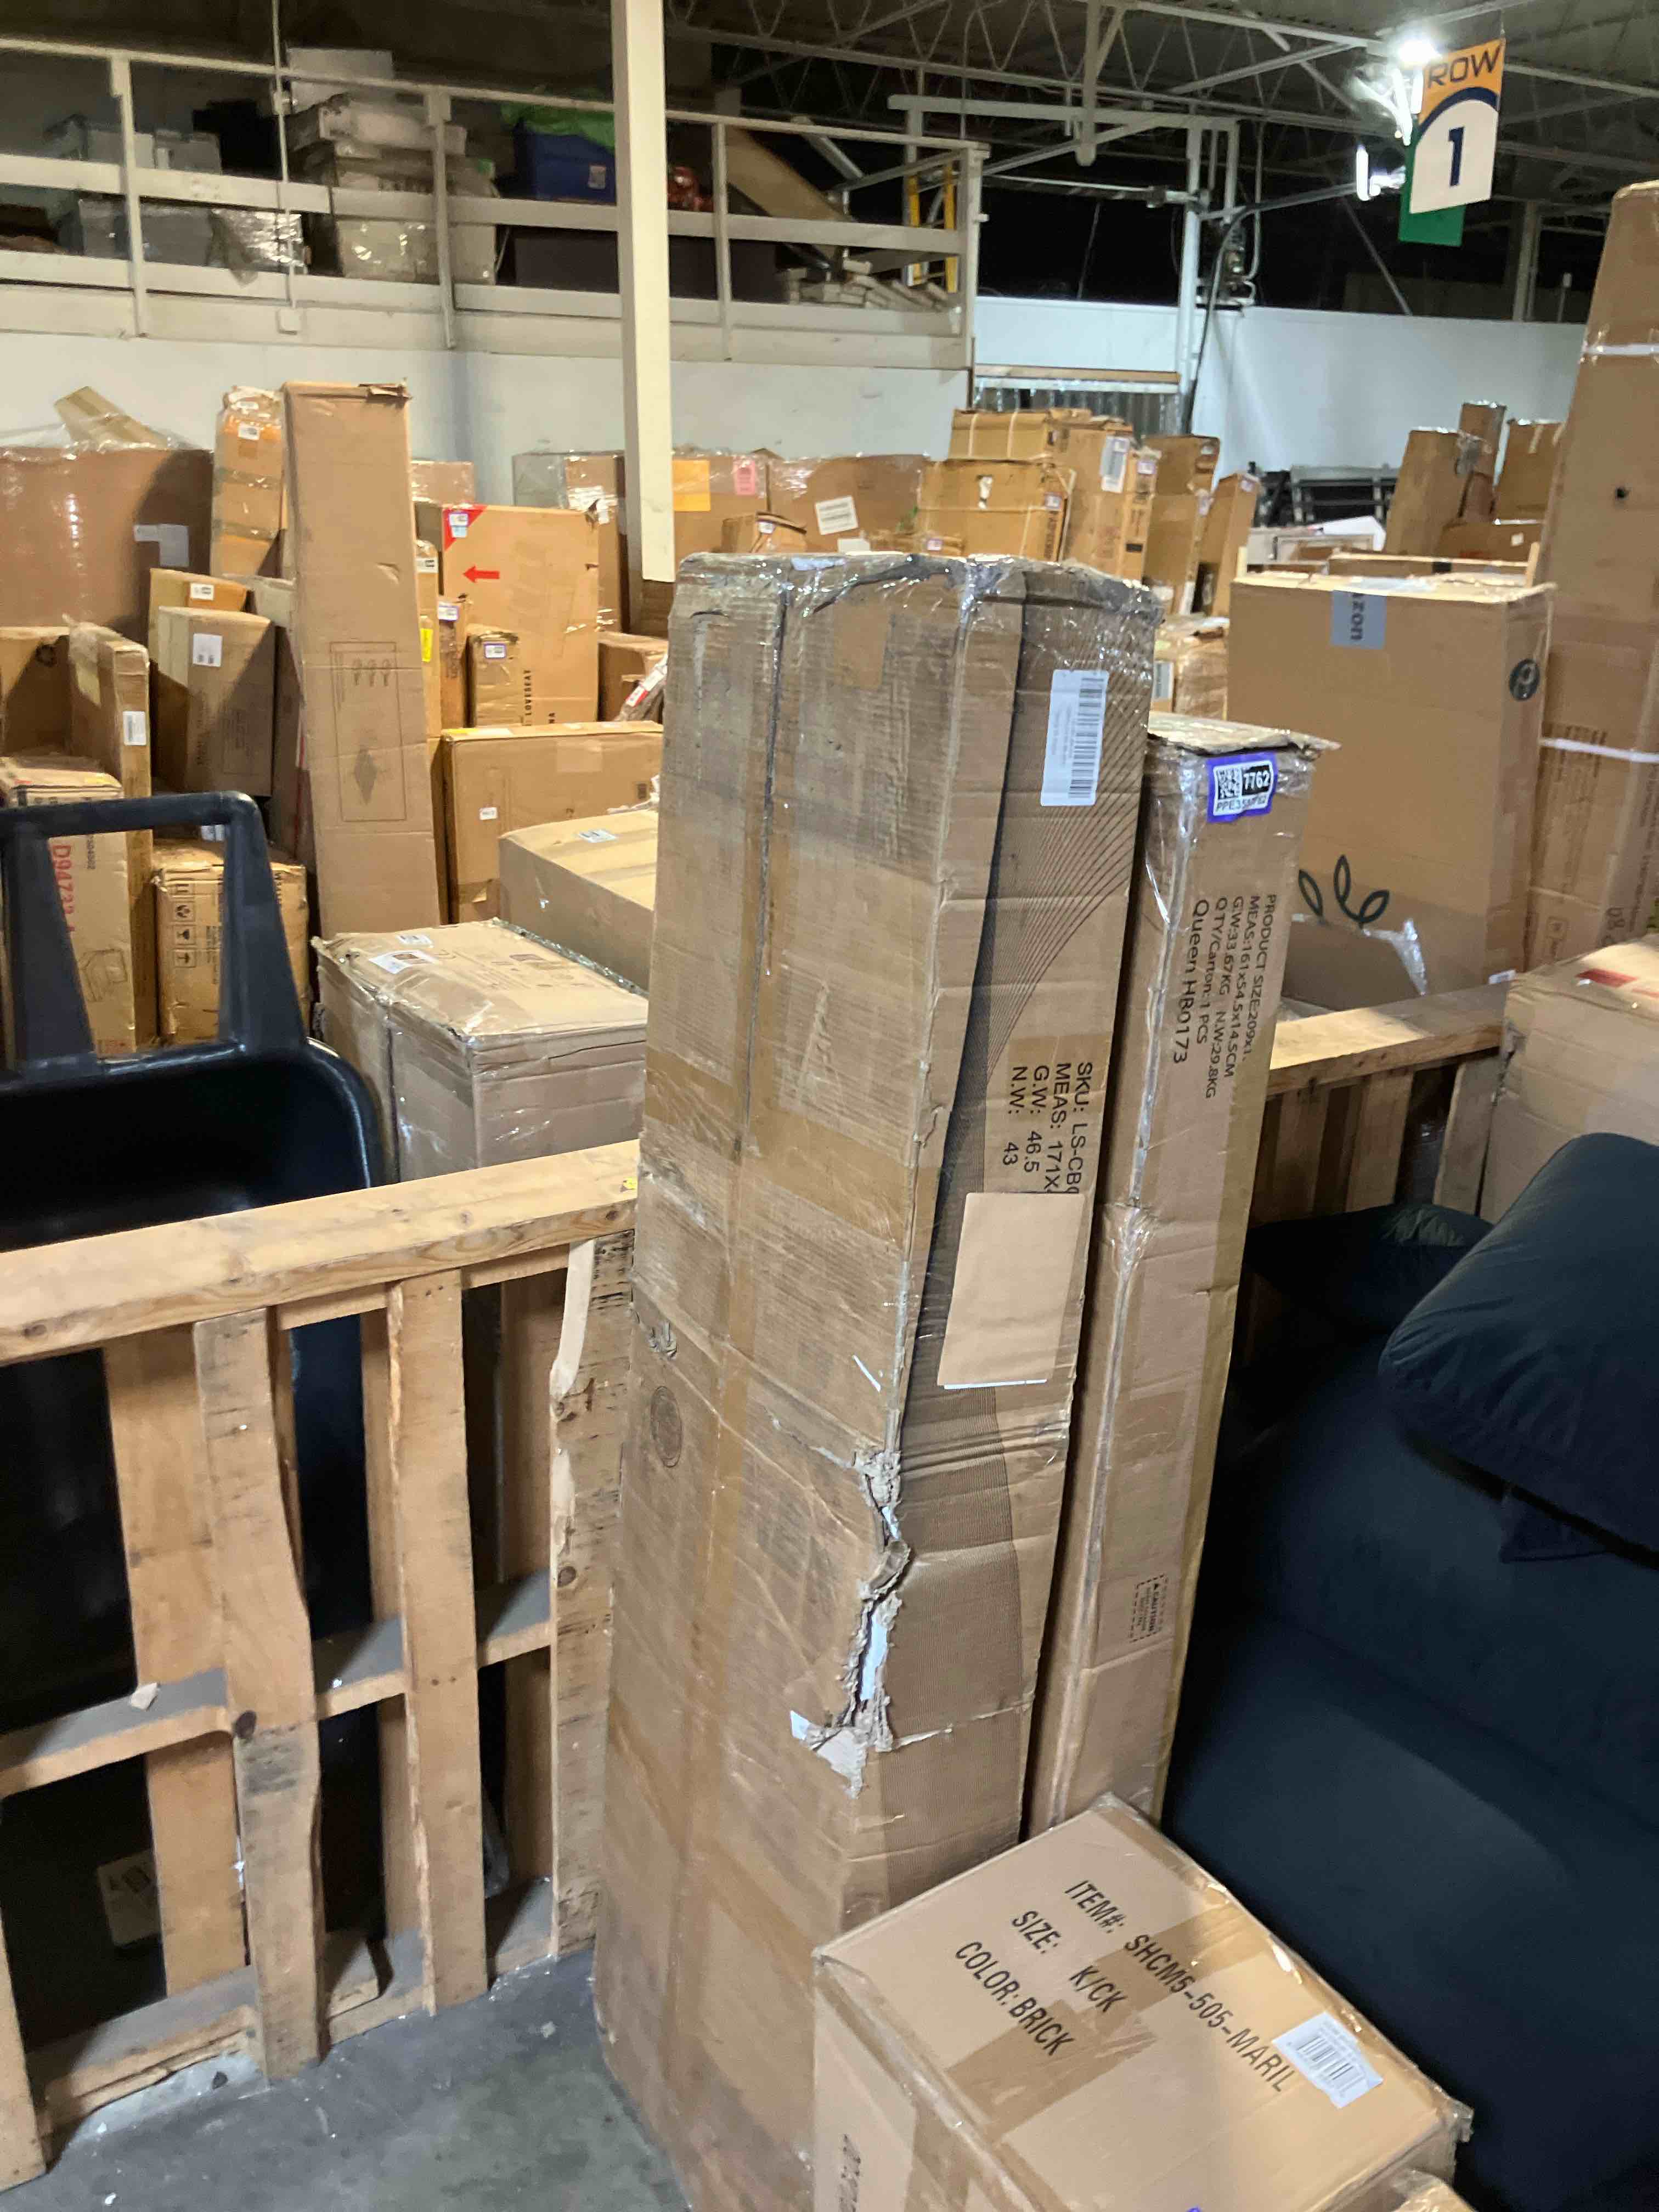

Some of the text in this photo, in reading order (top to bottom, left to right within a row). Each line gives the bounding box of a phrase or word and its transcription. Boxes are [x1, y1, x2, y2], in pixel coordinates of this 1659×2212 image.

[1428, 44, 1502, 88] ROW
[1448, 126, 1465, 187] 1
[1351, 594, 1364, 641] zon
[523, 670, 532, 716] LOVESEAT
[1242, 770, 1269, 791] 7762
[1255, 894, 1277, 970] PRODUCT
[1173, 899, 1210, 1064] Queen HB0173
[1223, 895, 1261, 1079] MEAS:161x54.5x14.5CM
[1196, 1015, 1210, 1044] PCS
[1002, 1066, 1029, 1166] N.W: 43
[1024, 1065, 1049, 1173] G.W: 46.5
[1043, 1062, 1072, 1194] MEAS: 171X
[1073, 1062, 1093, 1113] SKU:
[955, 1941, 1075, 2056] COLOR: BRICK
[1011, 1910, 1128, 2013] SIZE: K/CK
[1064, 1880, 1125, 1934] ITEM#:
[1124, 1933, 1297, 2093] SHCM5-505-MARIL
